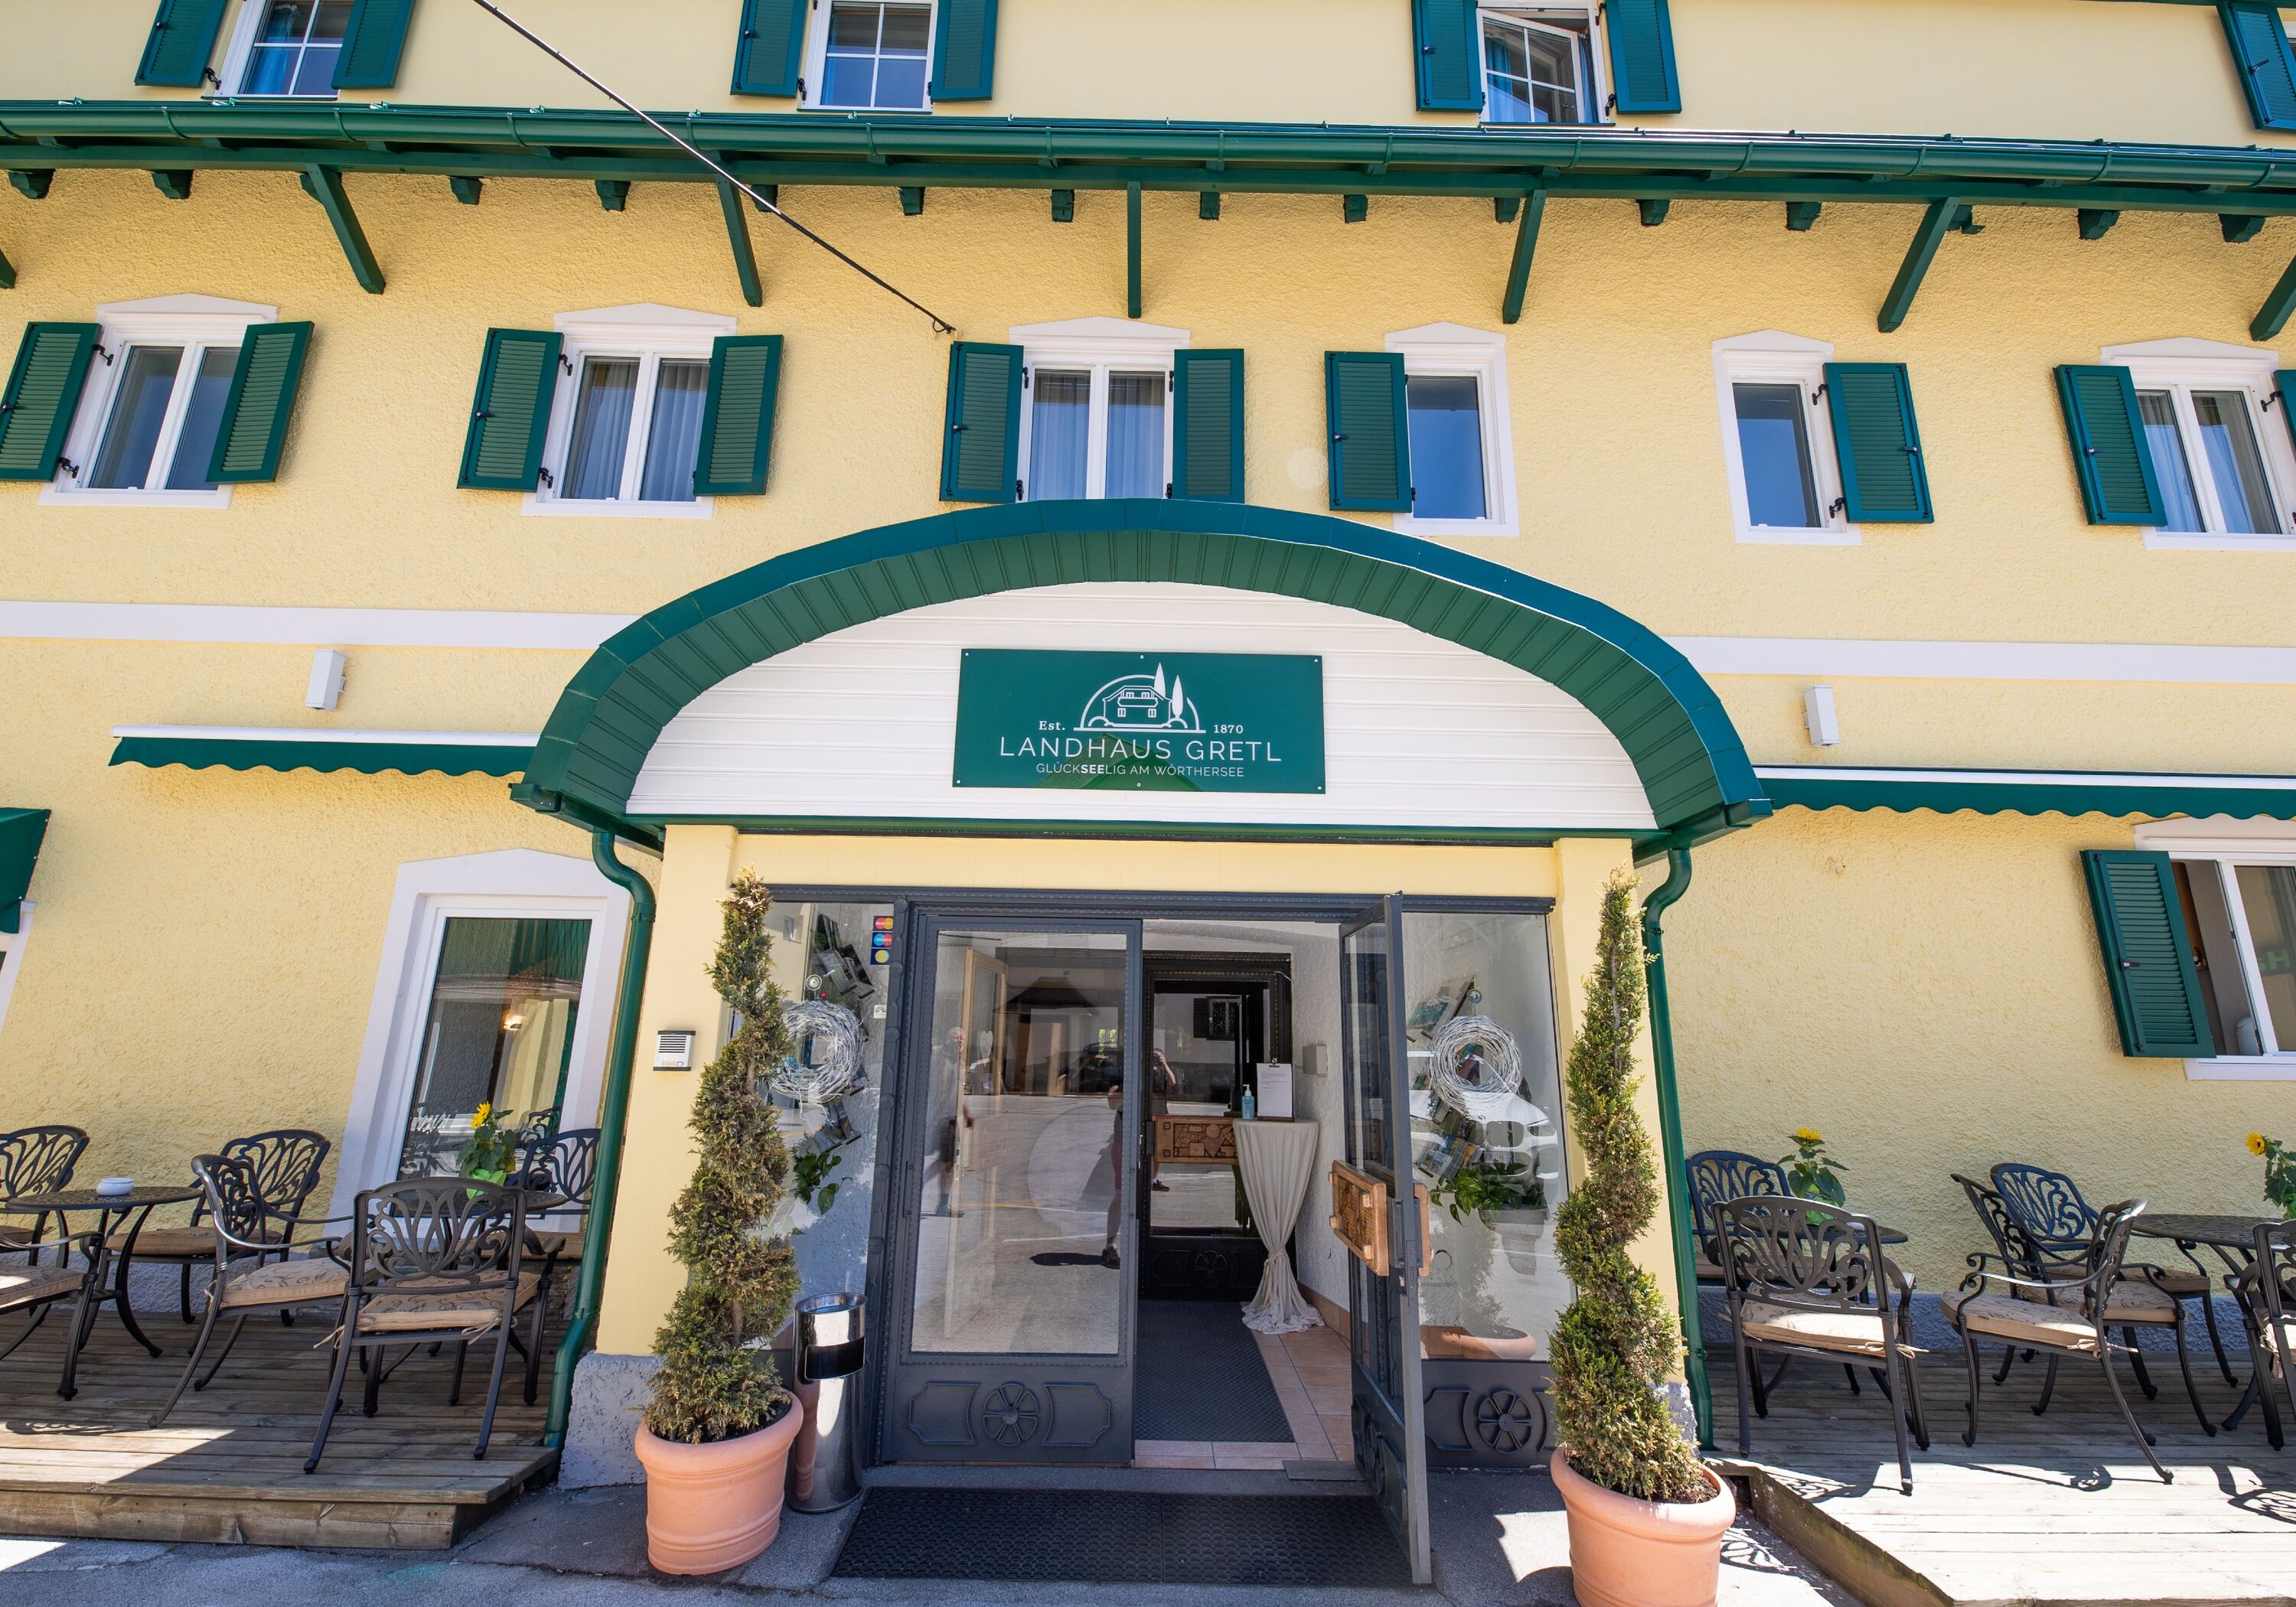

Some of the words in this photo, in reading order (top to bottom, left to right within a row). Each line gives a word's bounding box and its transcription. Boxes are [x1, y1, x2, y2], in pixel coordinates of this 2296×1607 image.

[1039, 720, 1065, 731] Est.
[1214, 724, 1244, 734] 1870
[1000, 736, 1171, 760] LANDHAUS
[1186, 740, 1282, 761] GRETL
[1036, 761, 1126, 774] GLÜCKSEELIG
[1130, 765, 1150, 775] AM
[1154, 764, 1244, 777] WÖRTHERSEE
